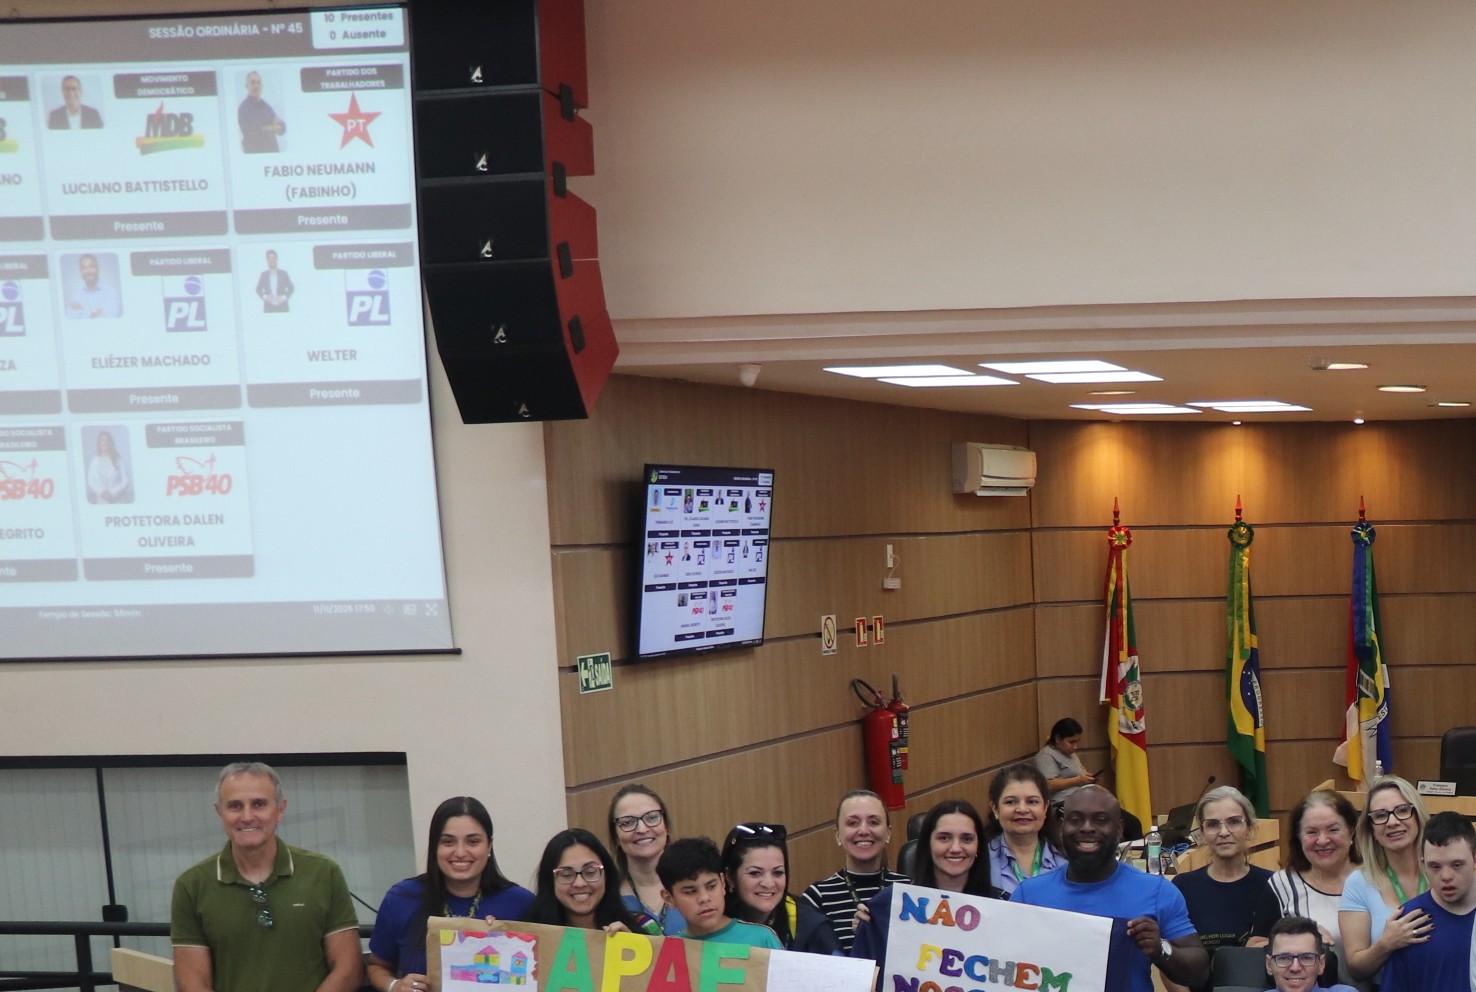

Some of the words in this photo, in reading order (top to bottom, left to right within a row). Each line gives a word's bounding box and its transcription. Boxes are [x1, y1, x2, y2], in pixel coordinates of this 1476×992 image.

[323, 13, 335, 24] 10
[340, 10, 394, 24] Presentes
[149, 24, 194, 39] SESSÃO
[196, 22, 260, 37] ORDINÁRIA
[287, 23, 304, 35] 45
[329, 31, 337, 41] 0
[341, 28, 387, 41] Ausente
[145, 110, 194, 138] MDB
[347, 119, 366, 132] PT
[264, 164, 304, 178] FABIO
[307, 162, 376, 177] NEUMANN
[62, 181, 122, 196] LUCIANO
[125, 178, 209, 194] BATTISTELLO
[285, 184, 357, 201] (FABINHO)
[114, 220, 164, 233] Presente
[297, 214, 348, 227] Presente
[167, 304, 206, 330] PL
[350, 298, 389, 323] PL
[91, 353, 138, 369] ELIÉZER
[141, 353, 211, 368] MACHADO
[307, 348, 357, 362] WELTER
[130, 392, 179, 405] Presente
[310, 387, 360, 400] Presente
[105, 514, 180, 529] PROTETORA
[183, 512, 224, 527] DALEN
[138, 534, 195, 549] OLIVEIRA
[144, 561, 193, 575] Presente
[899, 892, 981, 931] NÃO
